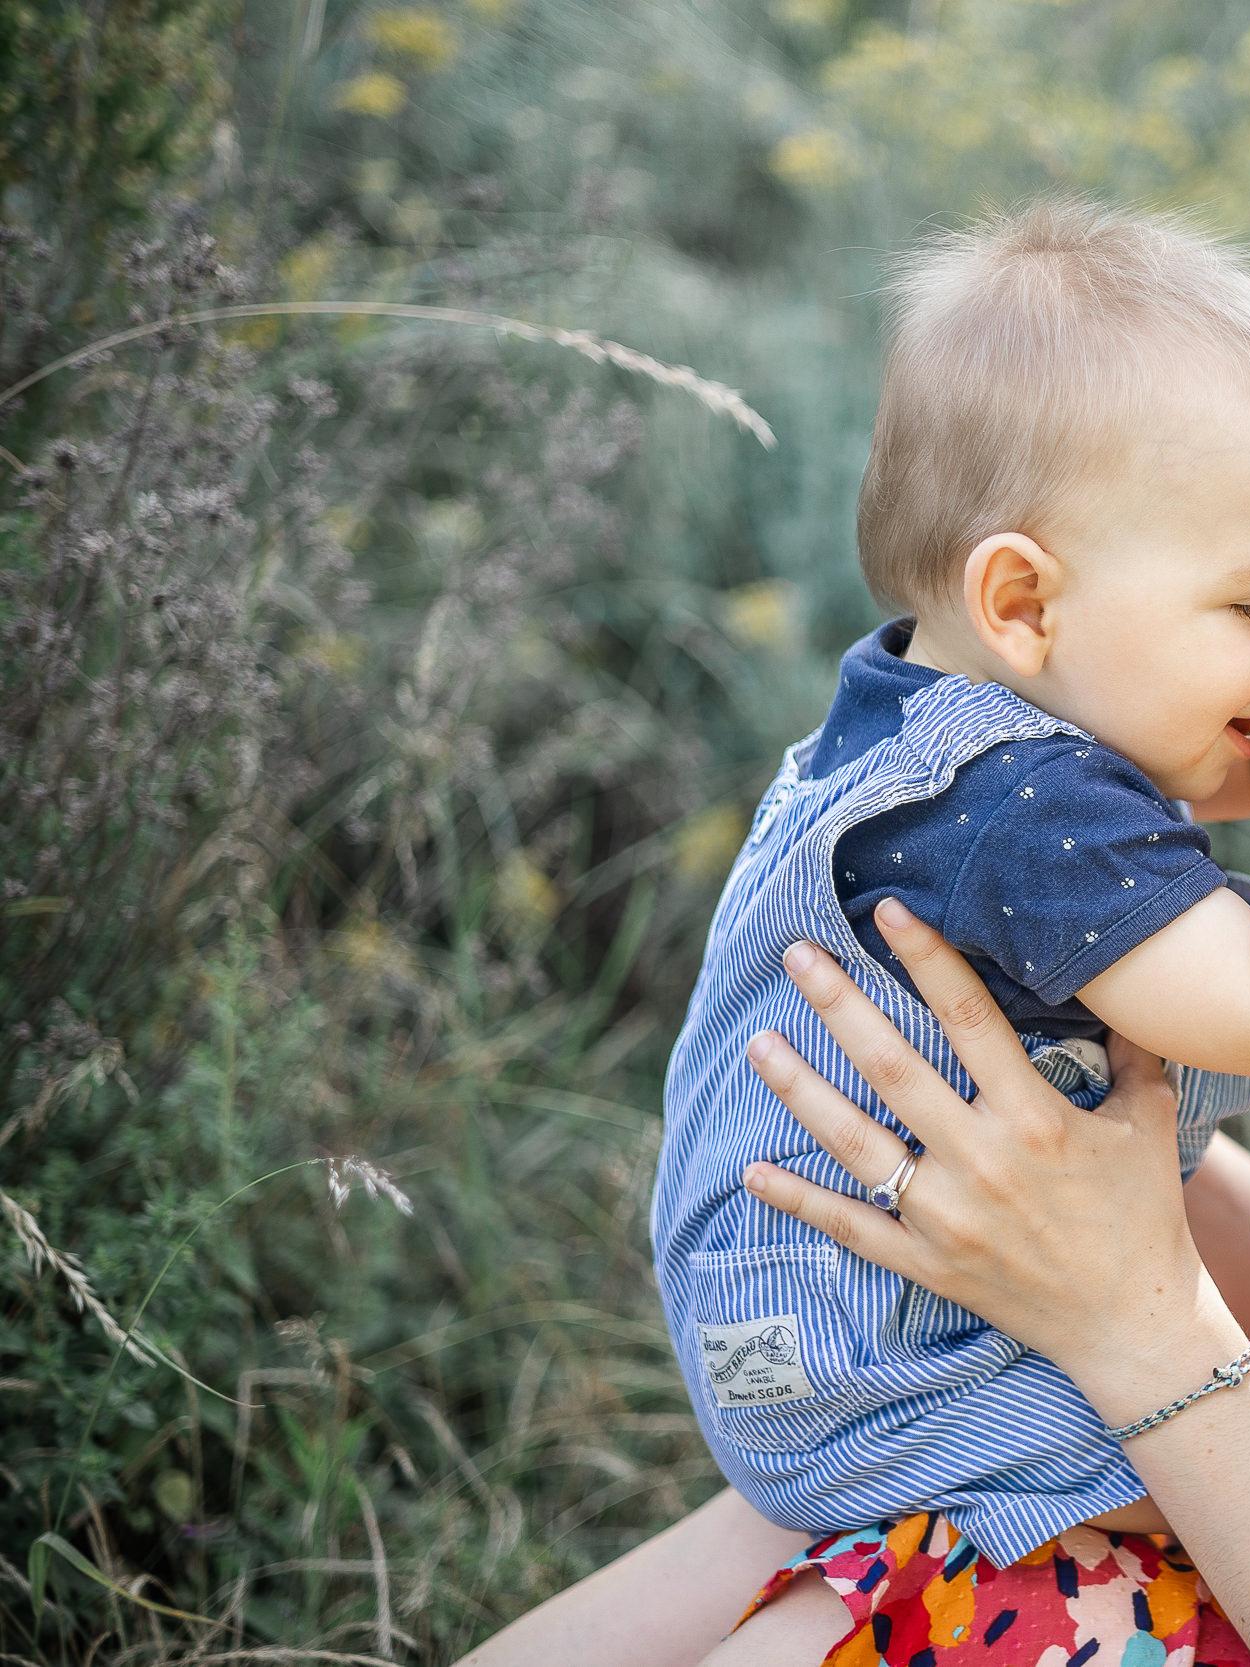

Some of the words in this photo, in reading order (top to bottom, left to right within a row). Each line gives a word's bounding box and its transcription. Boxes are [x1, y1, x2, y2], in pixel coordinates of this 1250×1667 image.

[715, 1365, 735, 1381] PETIT
[733, 1340, 756, 1368] BATEAU
[743, 1367, 773, 1377] GARANTI
[746, 1375, 776, 1385] LAVABLE
